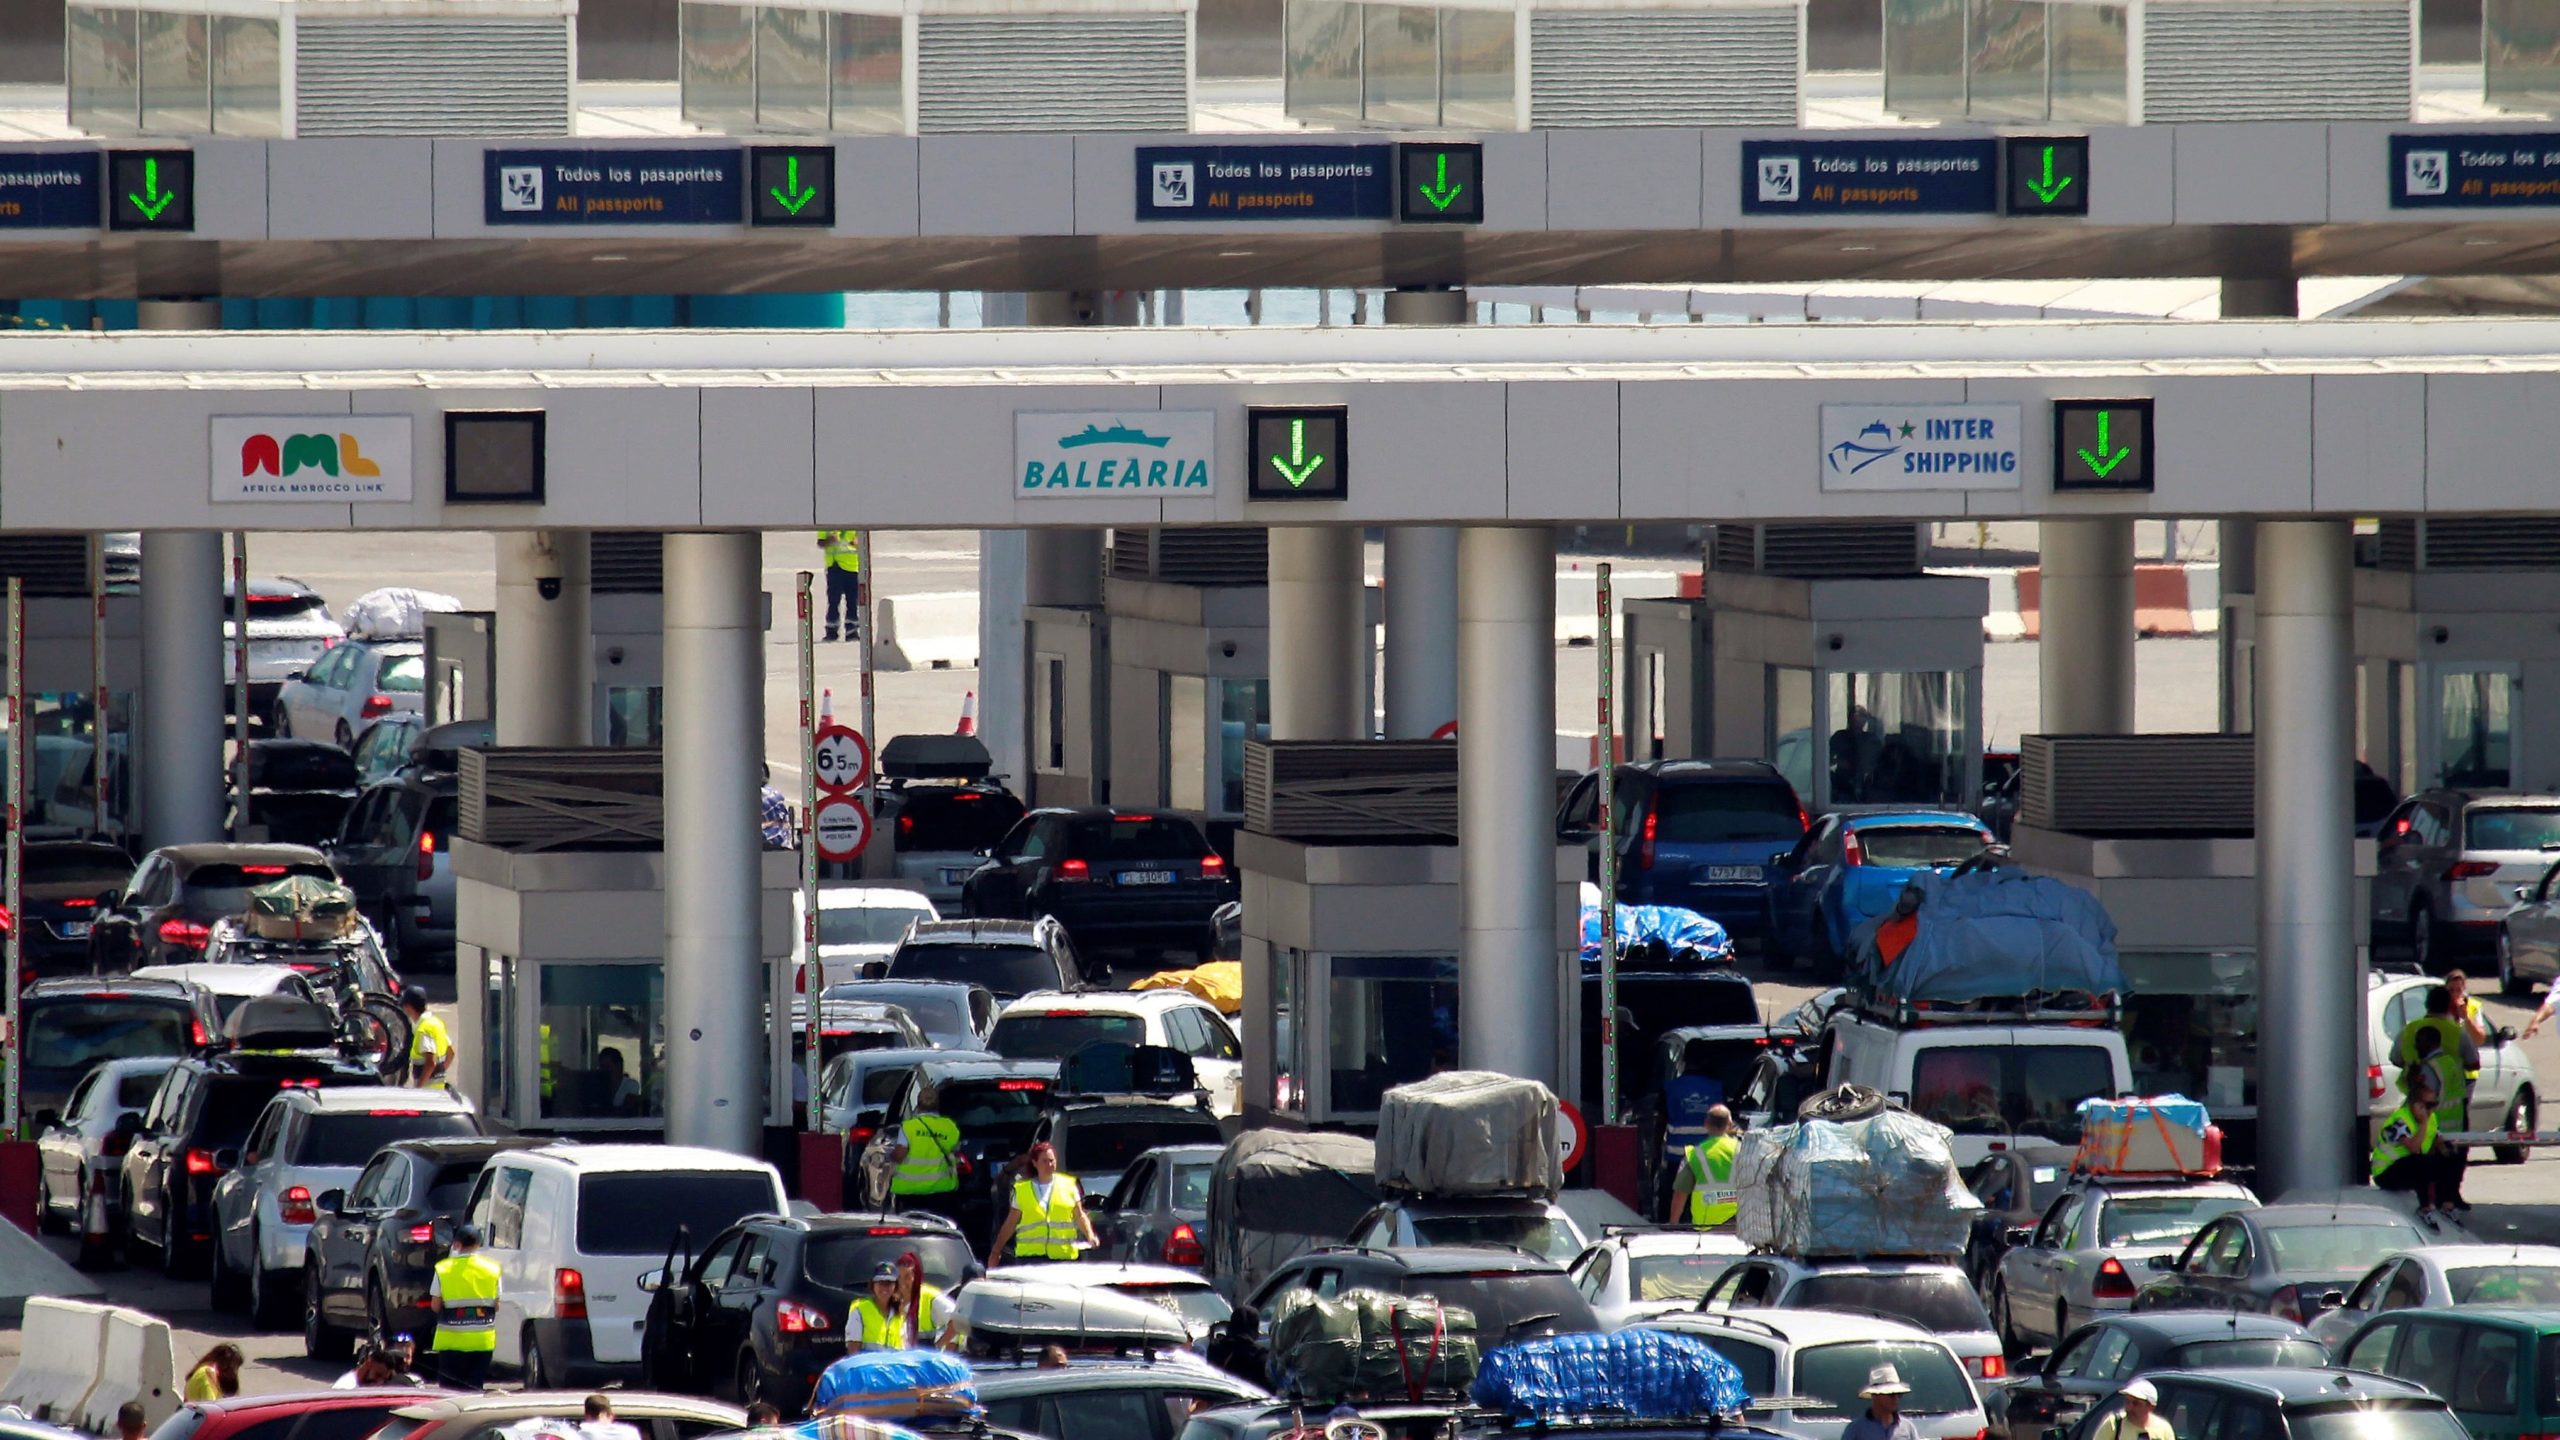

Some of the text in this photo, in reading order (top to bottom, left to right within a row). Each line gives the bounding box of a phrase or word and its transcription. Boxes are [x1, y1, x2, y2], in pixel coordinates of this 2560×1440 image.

[1812, 157, 1980, 175] Todos los pasaportes
[2459, 151, 2507, 167] Todos
[2513, 150, 2536, 166] los
[555, 167, 723, 185] Todos los pasaportes
[1207, 162, 1373, 180] Todos los pasaportes
[1812, 185, 1919, 204] All passports
[2461, 180, 2483, 194] All
[556, 196, 664, 214] All passports
[1208, 192, 1314, 209] All passports
[1926, 419, 1994, 440] INTER
[241, 432, 381, 477] AML
[1904, 452, 2016, 473] SHIPPING
[242, 484, 383, 493] AFRICA MOROCCO LINK
